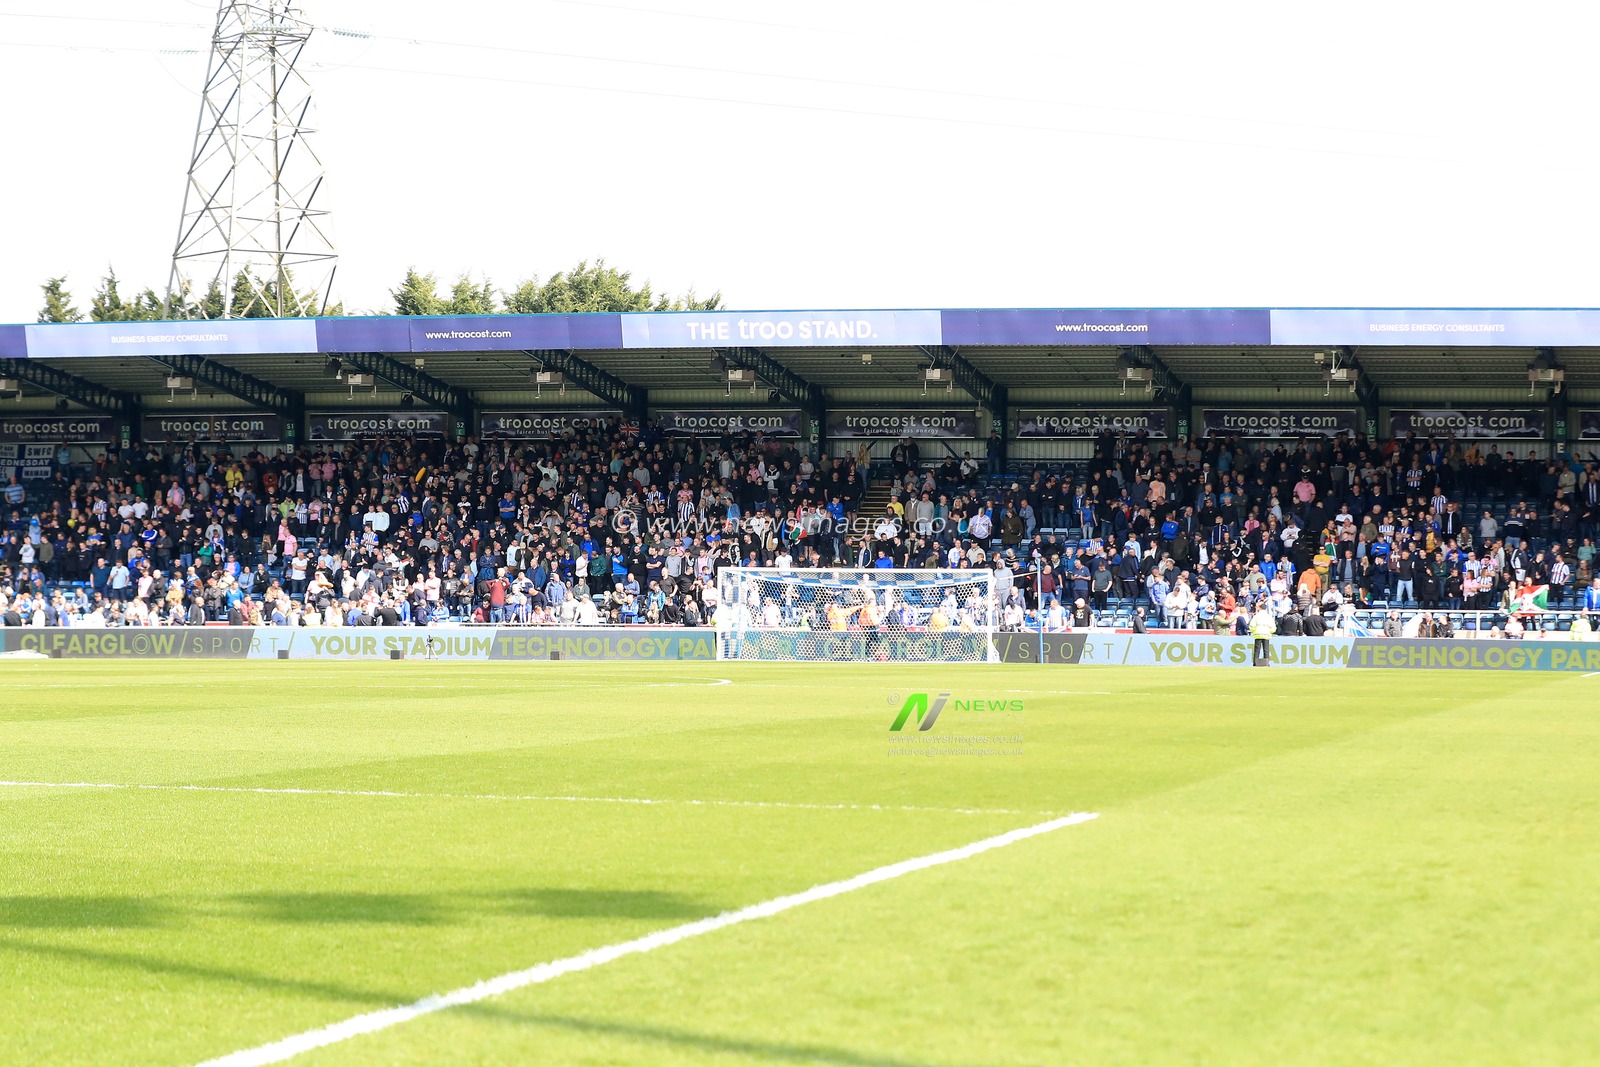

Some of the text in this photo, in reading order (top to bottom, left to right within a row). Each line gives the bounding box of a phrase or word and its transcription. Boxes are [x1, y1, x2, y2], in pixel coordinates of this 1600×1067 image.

[686, 318, 879, 340] THE troo STAND.
[1055, 322, 1148, 333] www.troocost.com
[1369, 323, 1505, 333] BUSINESS ENERGY CONSULTANTS
[111, 333, 229, 344] BUSINESS ENERGY CONSULTANTS
[425, 328, 512, 340] www.troocost.com
[121, 438, 130, 449] B
[286, 443, 294, 454] B
[27, 446, 53, 457] SWFC
[192, 637, 280, 654] SPORT
[310, 636, 492, 656] YOUR STADIUM
[498, 636, 671, 658] TECHNOLOGY
[1149, 641, 1224, 663] YOUR
[1356, 645, 1544, 669] TECHNOLOGY
